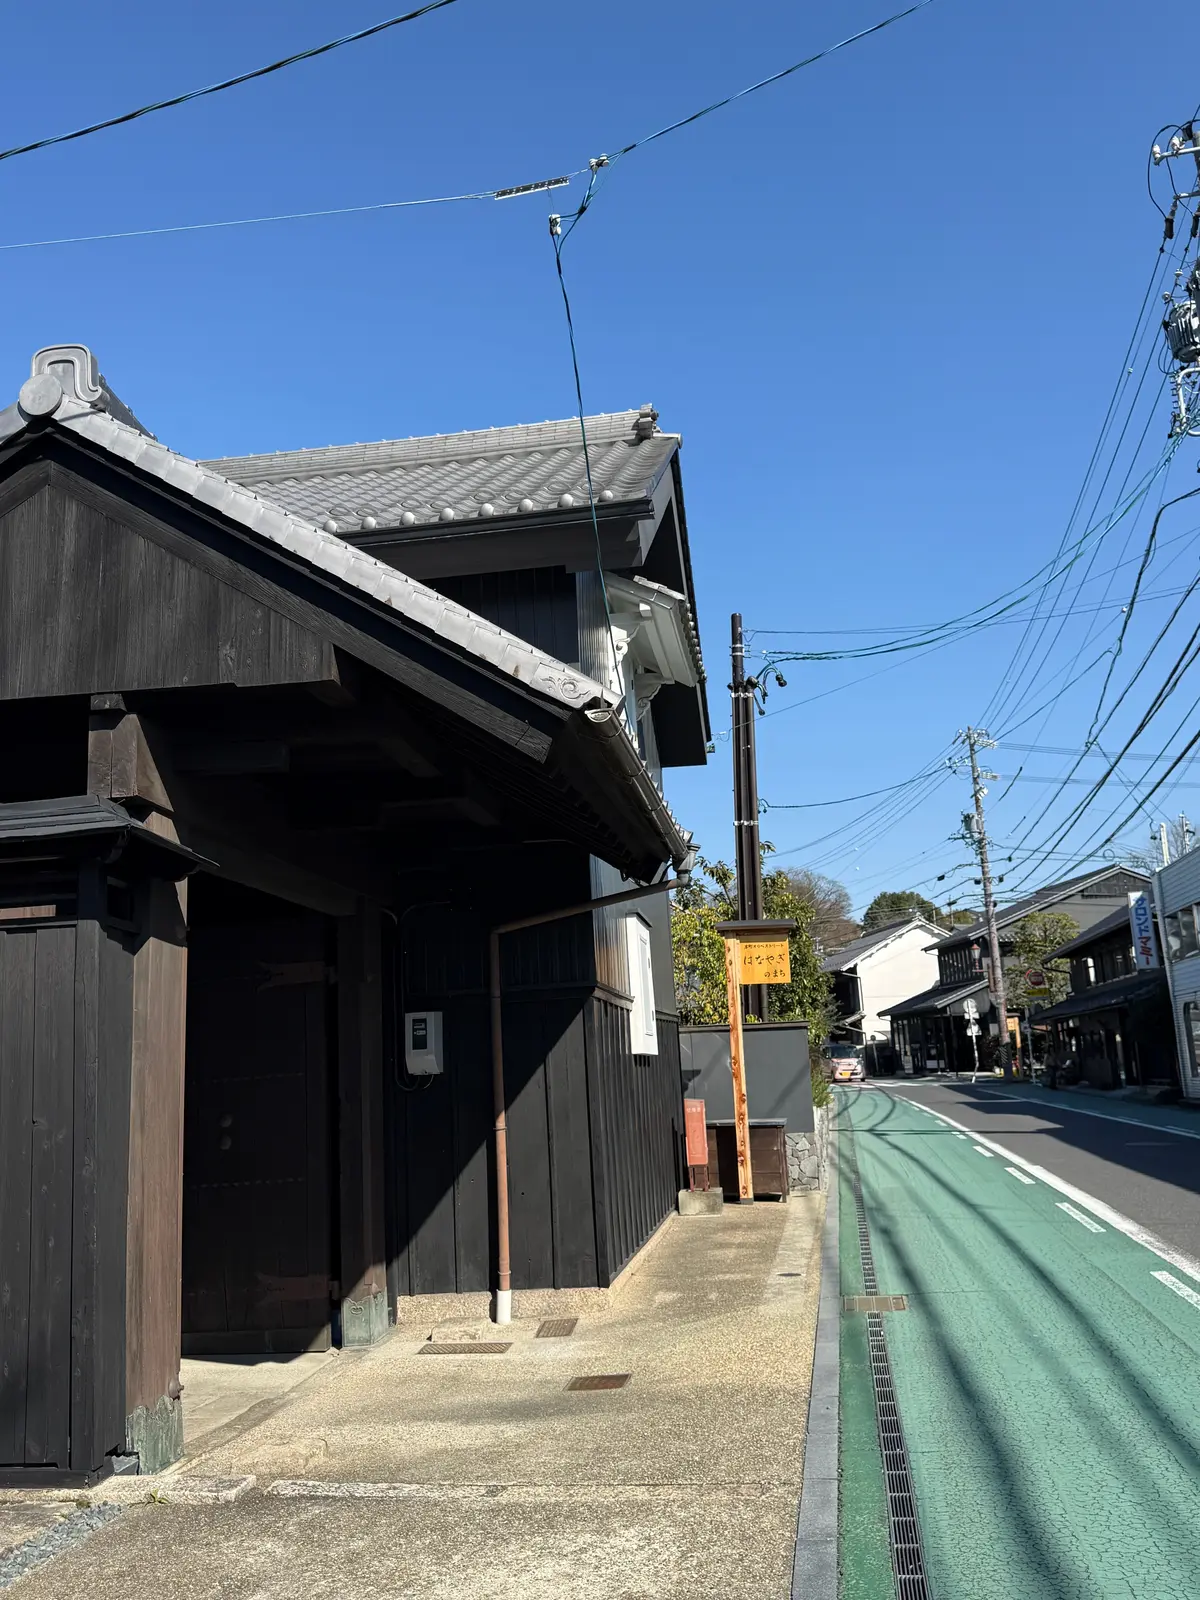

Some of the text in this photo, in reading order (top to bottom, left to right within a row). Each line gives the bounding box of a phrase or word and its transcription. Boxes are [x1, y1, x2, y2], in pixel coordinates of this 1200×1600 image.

[1133, 896, 1153, 966] サロンドマミー
[743, 953, 785, 966] はなやぎ
[764, 969, 786, 978] のまち
